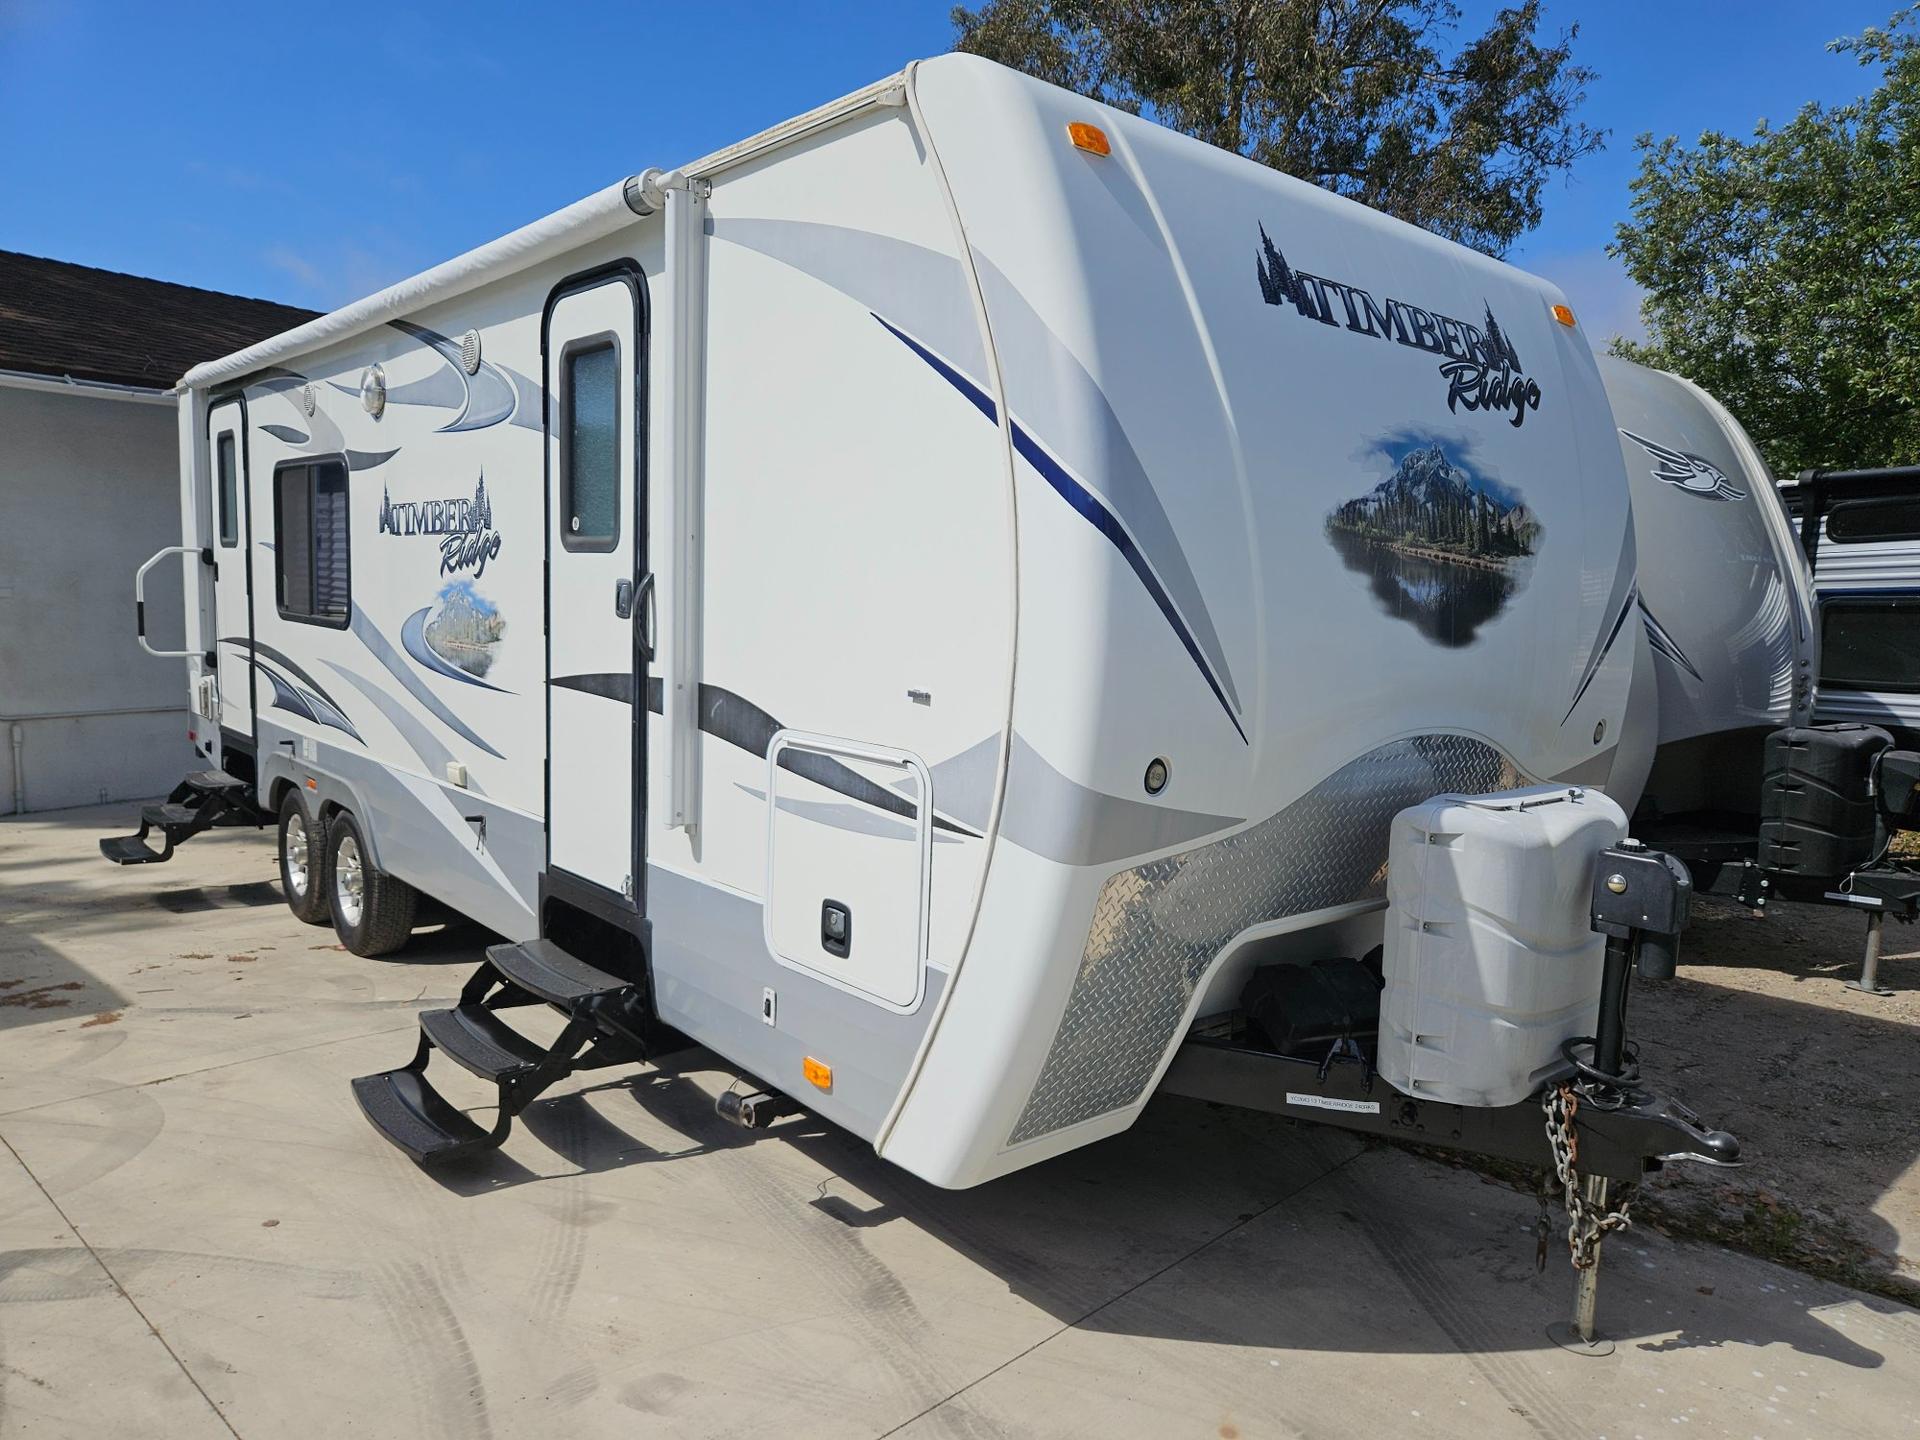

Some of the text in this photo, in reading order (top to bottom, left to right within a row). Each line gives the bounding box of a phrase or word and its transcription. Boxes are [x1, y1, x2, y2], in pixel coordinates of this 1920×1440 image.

[1294, 269, 1489, 366] TIMBER
[1438, 360, 1541, 428] Ridge
[391, 498, 475, 536] TIMBER
[439, 522, 501, 580] Ridge
